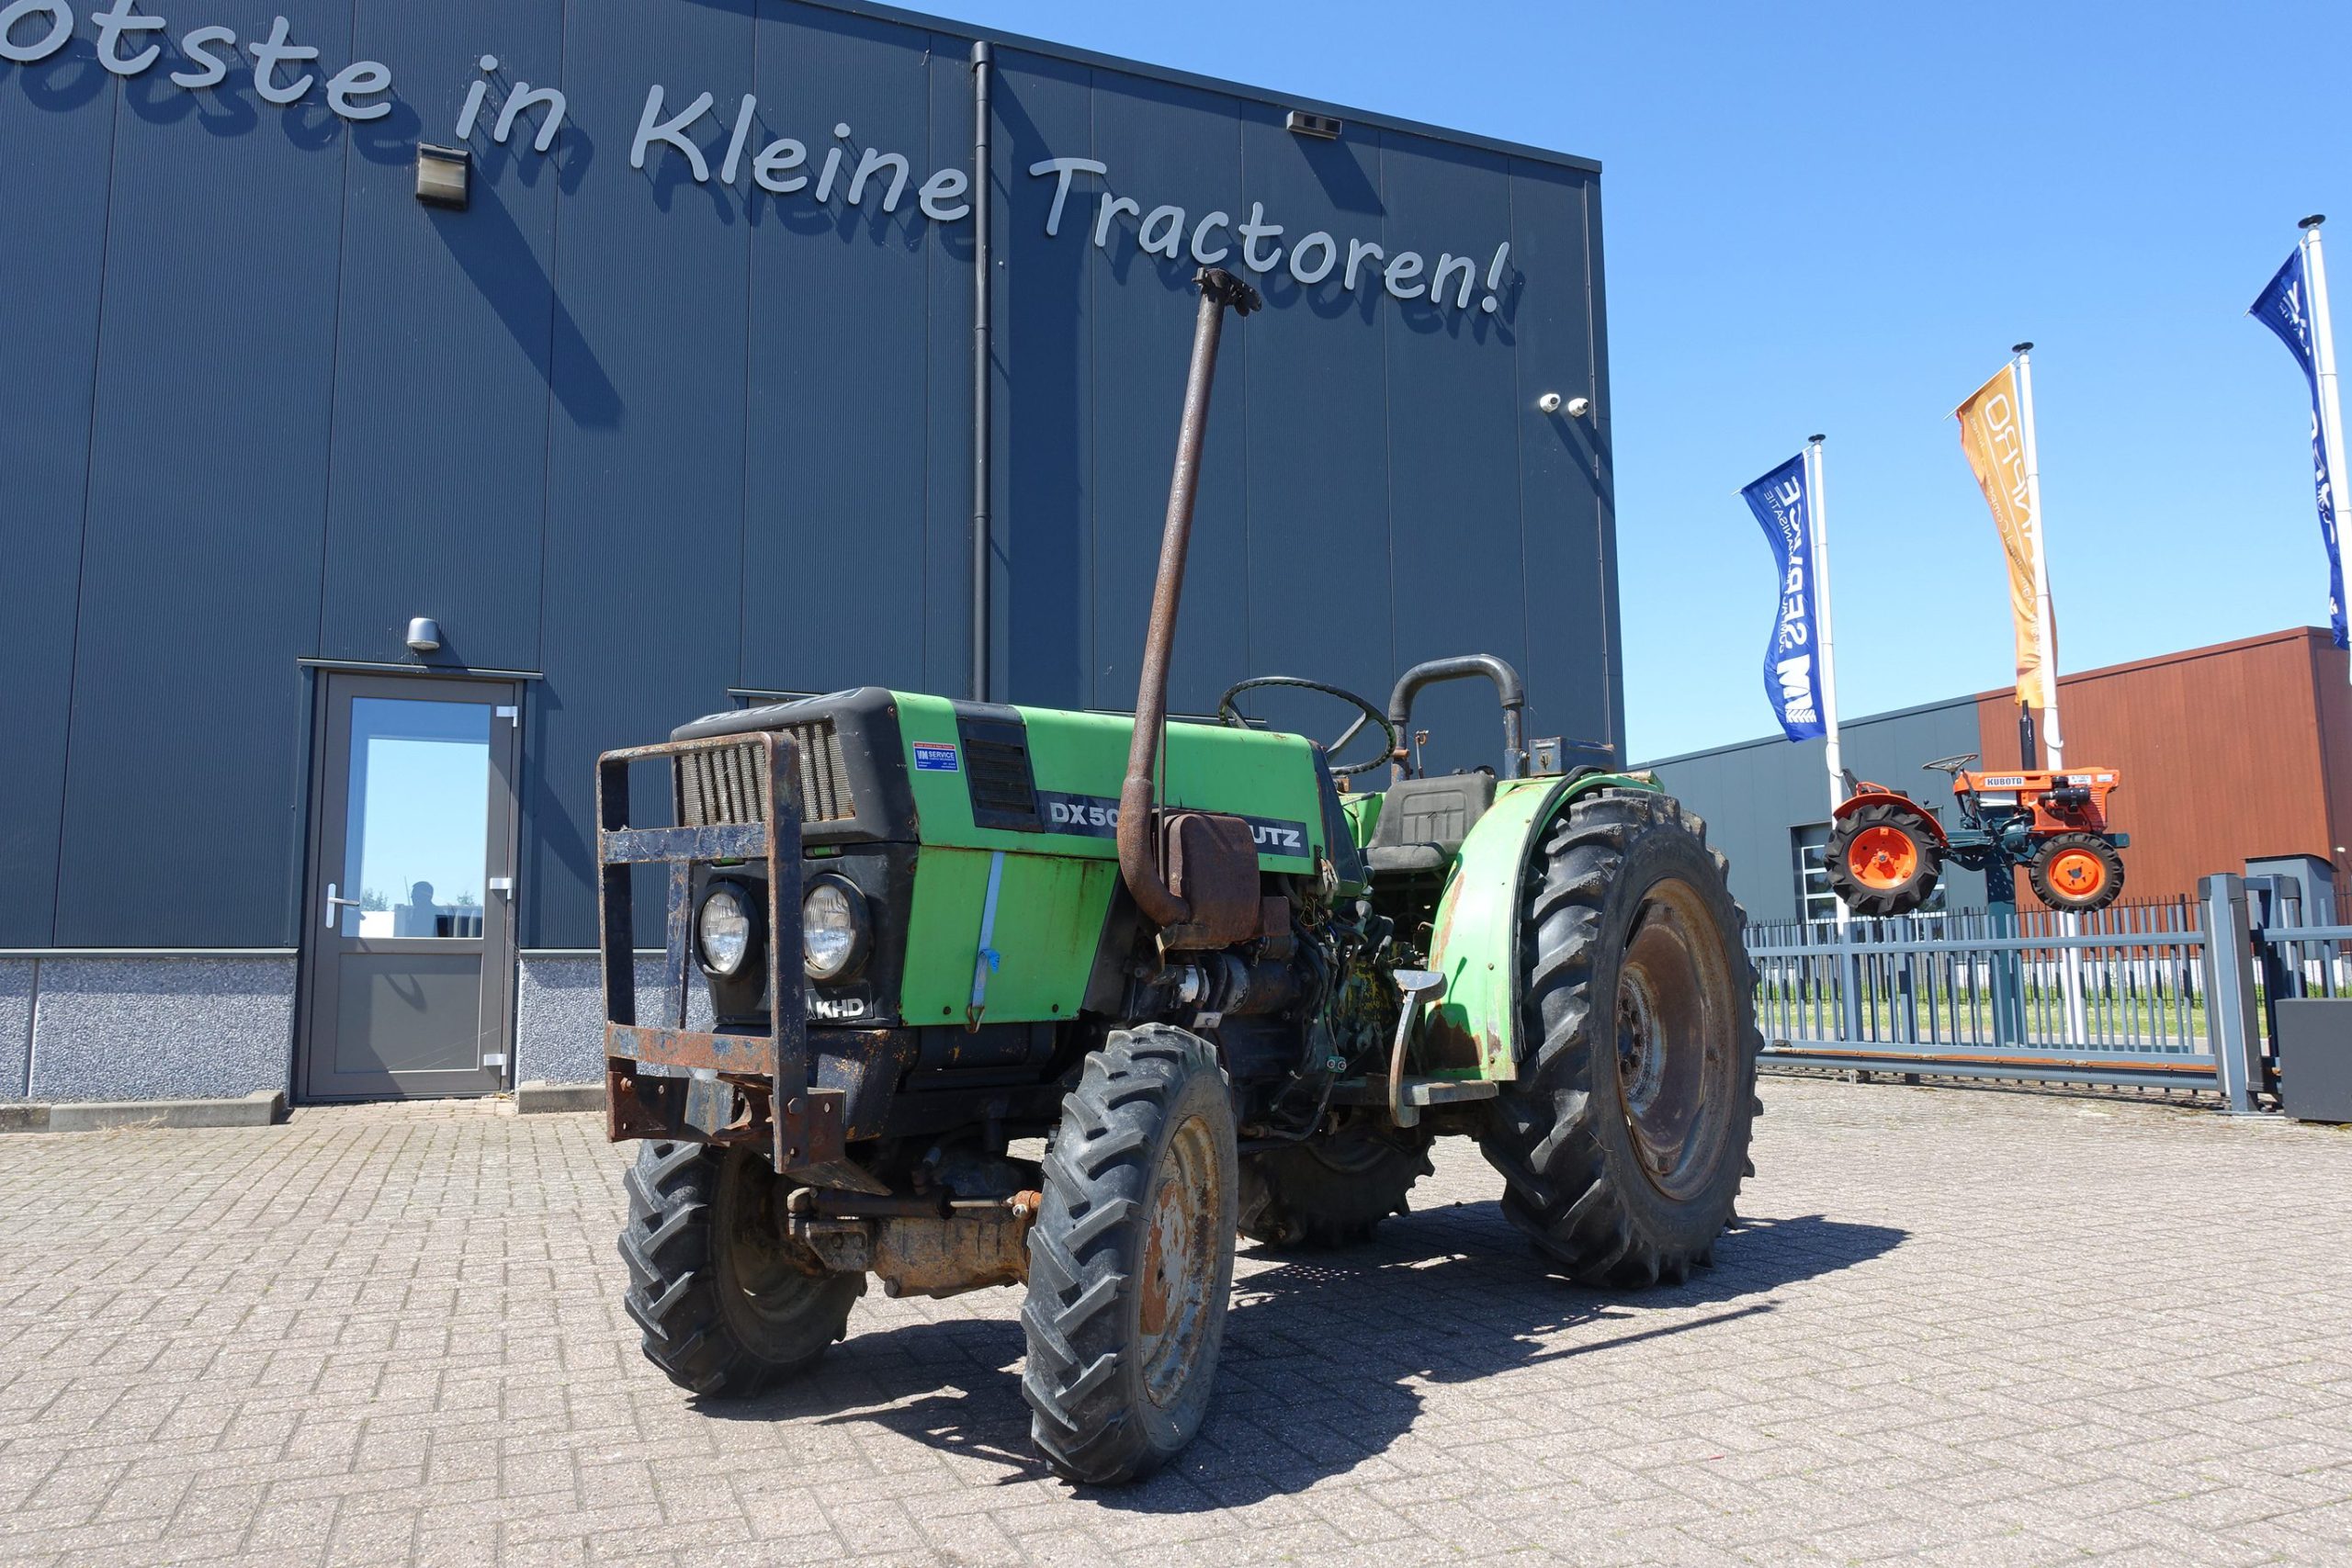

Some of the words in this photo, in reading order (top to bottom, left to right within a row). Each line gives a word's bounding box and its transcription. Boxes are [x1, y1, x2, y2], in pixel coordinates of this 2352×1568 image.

[0, 0, 391, 119] otste
[456, 54, 566, 151] in
[630, 85, 970, 220] Kleine
[1029, 157, 1510, 313] Tractoren!
[1251, 826, 1301, 848] UTZ
[816, 998, 865, 1019] KHD
